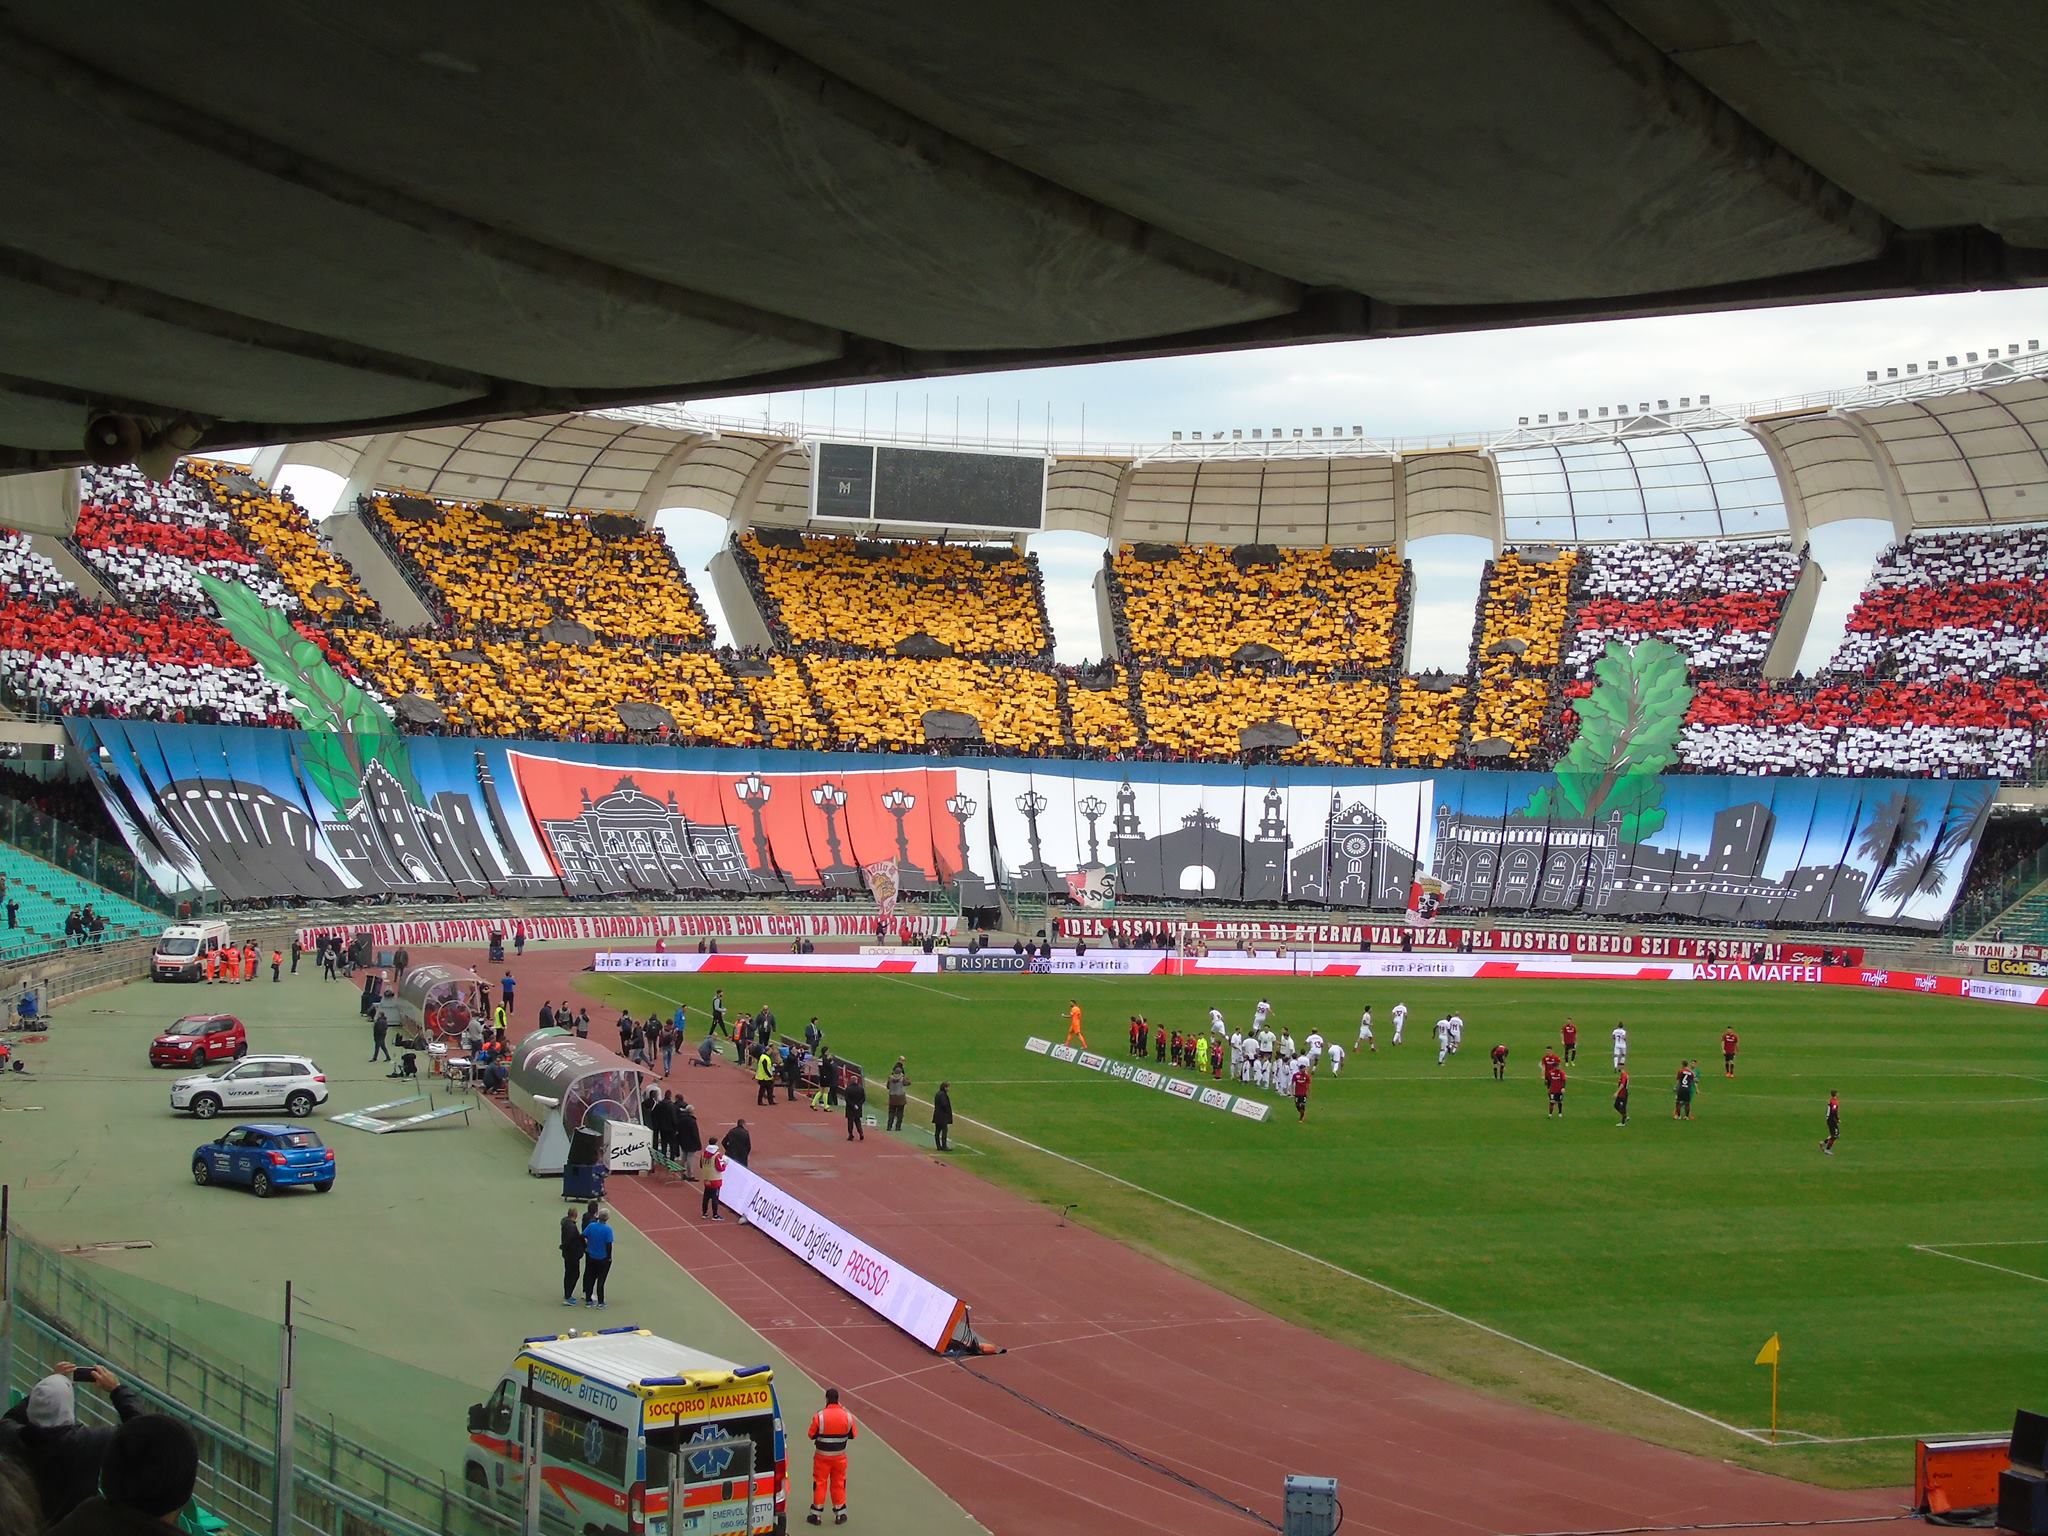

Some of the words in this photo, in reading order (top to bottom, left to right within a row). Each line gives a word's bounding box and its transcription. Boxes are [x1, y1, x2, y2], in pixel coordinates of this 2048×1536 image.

[509, 916, 578, 939] CSTODIRE
[581, 917, 589, 938] E
[592, 916, 676, 938] GUARDATELA
[679, 915, 732, 936] SEMPRE
[735, 915, 763, 936] CON
[768, 916, 806, 936] OCCHI
[811, 916, 829, 936] DA
[1064, 918, 1104, 936] IDEA
[1216, 923, 1262, 940] AMOR
[1269, 924, 1287, 941] DI
[1295, 925, 1362, 944] ETERNA
[1500, 931, 1569, 950] NOSTRO
[1577, 934, 1632, 953] CREDO
[1641, 938, 1669, 955] SEI
[1790, 952, 1841, 964] Segui
[1974, 945, 2005, 957] TRANI
[961, 957, 1025, 969] RISPETTO
[1029, 963, 1051, 973] 00:00
[2001, 960, 2048, 976] GoldBe
[1693, 964, 1742, 980] ASTA
[1748, 965, 1822, 982] MAFFEI
[1110, 1061, 1125, 1078] Serie
[1125, 1066, 1133, 1080] B
[1682, 1074, 1688, 1085] 6
[610, 1141, 645, 1160] Sixtus
[748, 1188, 784, 1228] Acquista
[782, 1208, 793, 1232] il
[789, 1215, 807, 1242] tuo
[803, 1223, 843, 1267] biglietto
[843, 1249, 890, 1296] PRESSO:
[532, 1366, 574, 1394] EMERVOL
[578, 1384, 618, 1412] BITETTO
[649, 1398, 705, 1417] SOCCORSO
[710, 1391, 768, 1410] AVANZATO
[712, 1507, 745, 1520] EMERVOL
